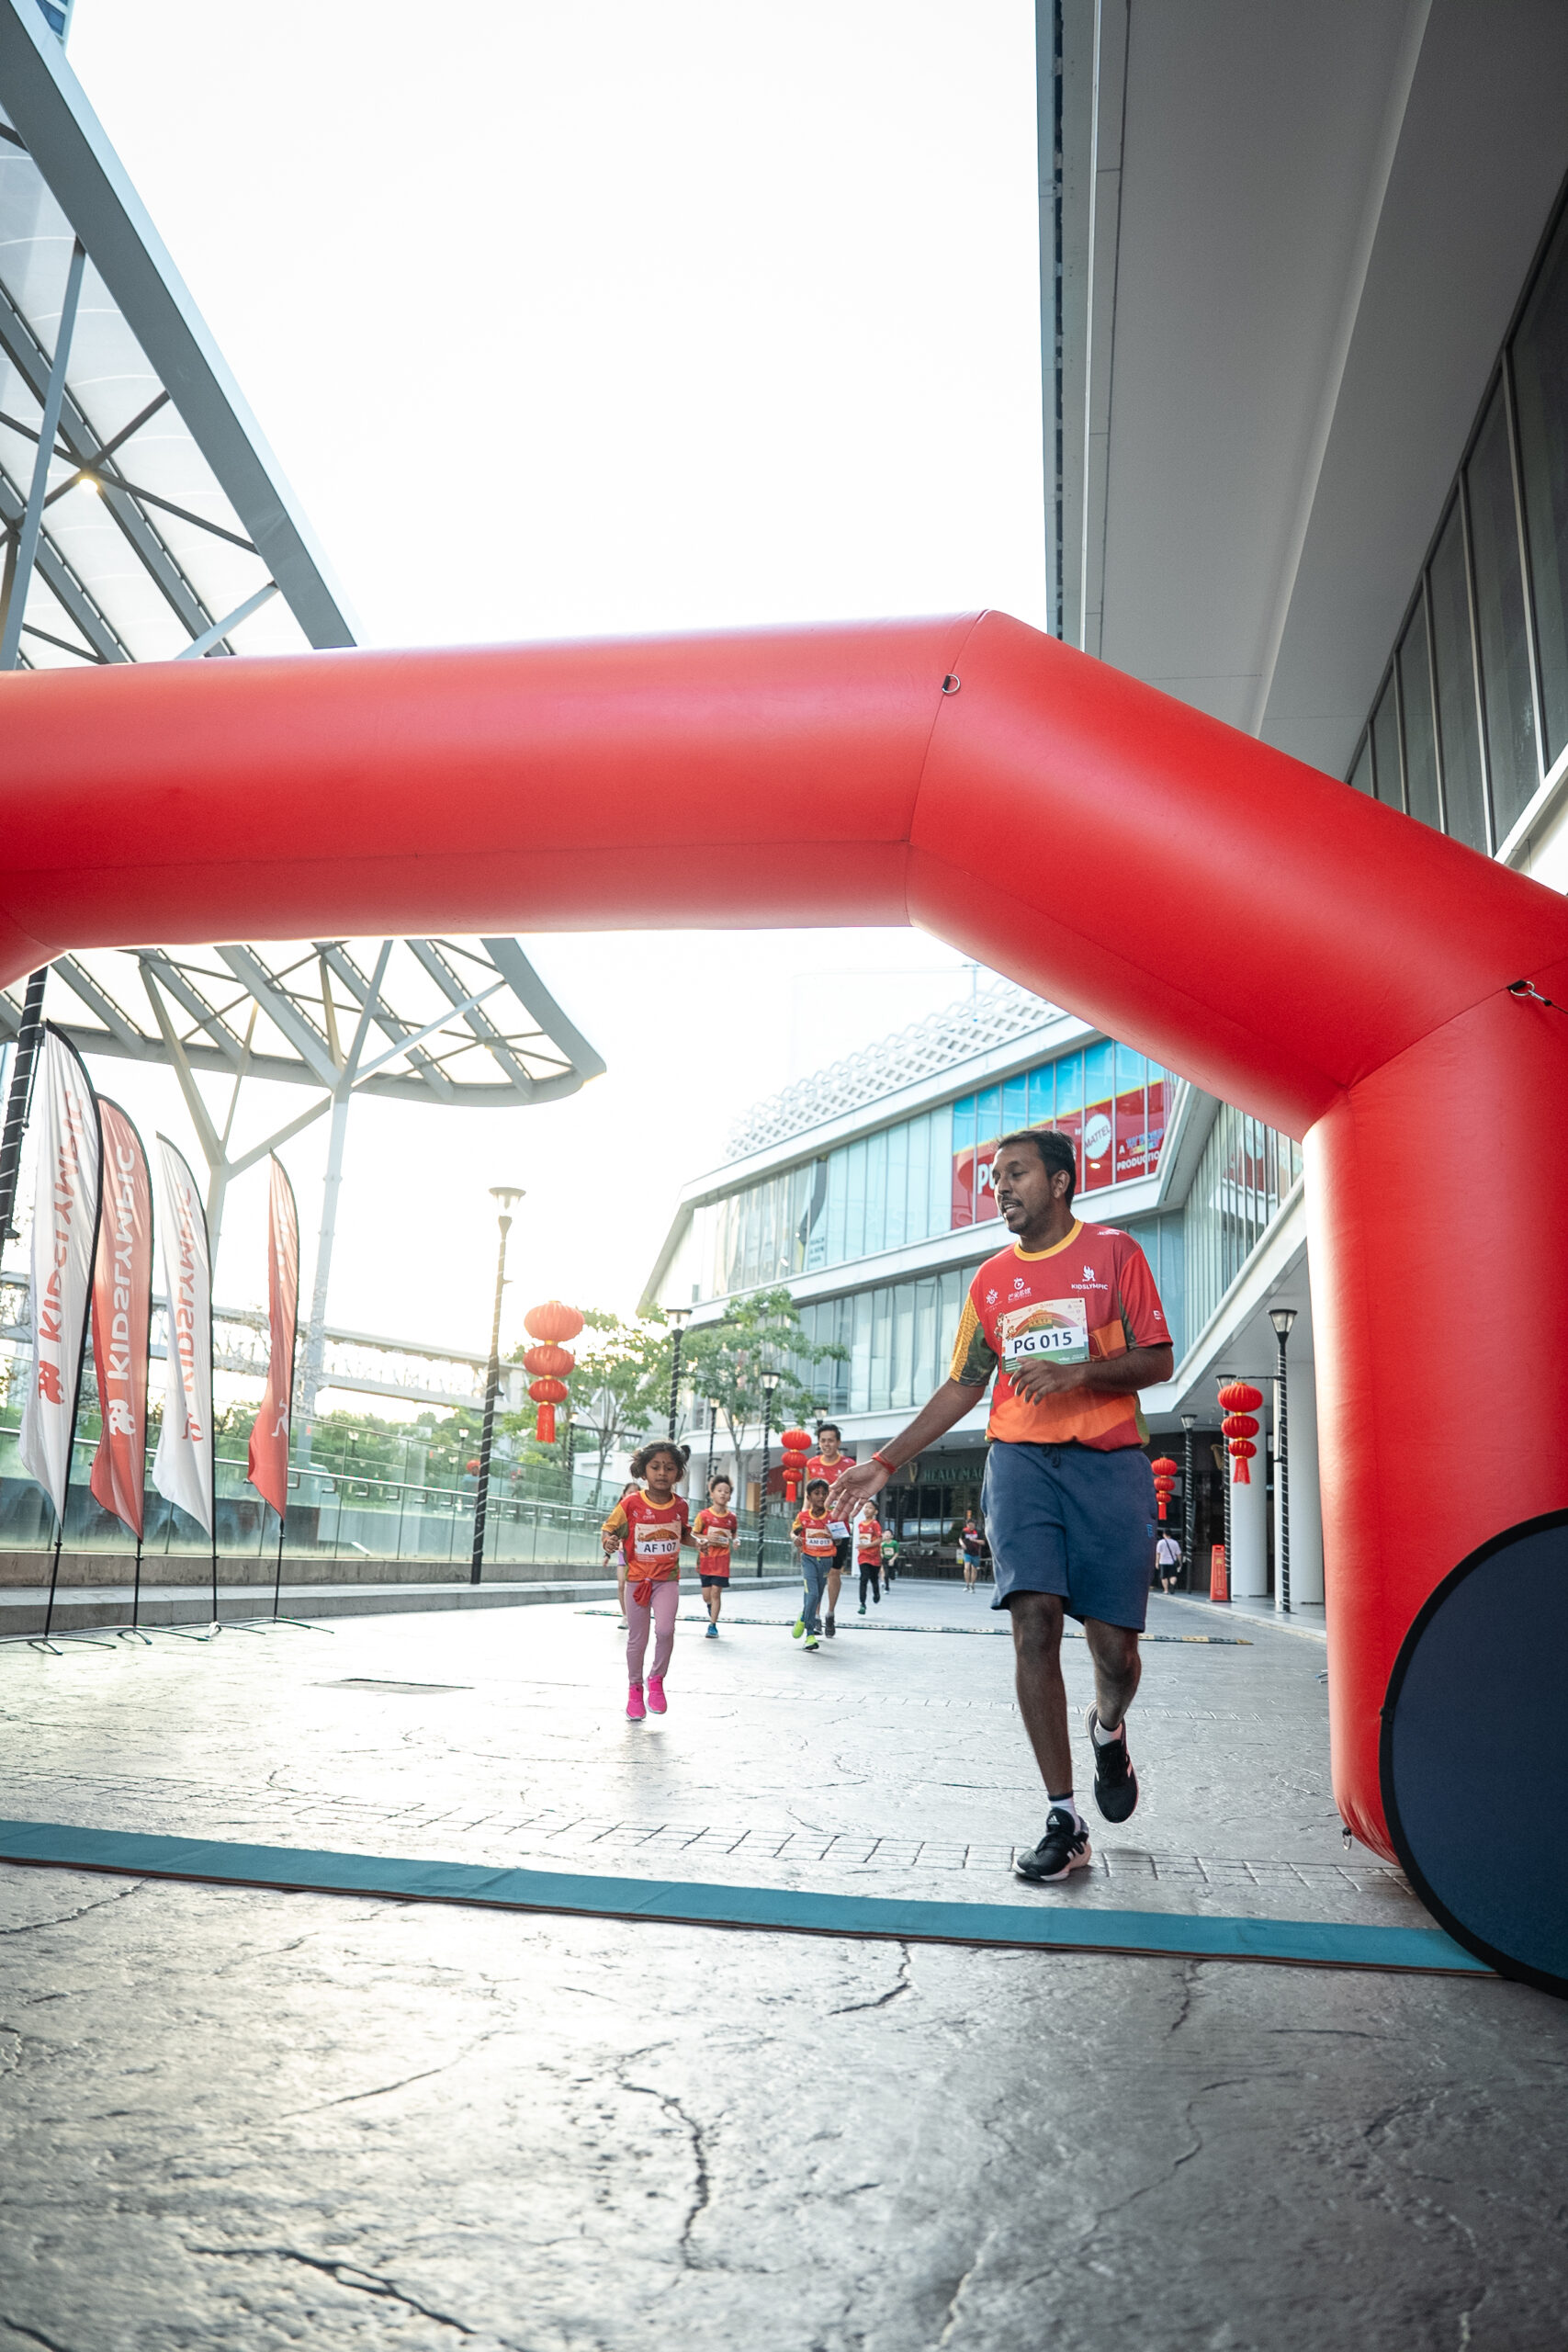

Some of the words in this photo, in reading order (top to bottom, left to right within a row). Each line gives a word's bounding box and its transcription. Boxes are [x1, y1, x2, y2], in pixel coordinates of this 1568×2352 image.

[1117, 1150, 1160, 1171] PRODUCTIO
[1014, 1337, 1035, 1354] PG
[1040, 1331, 1072, 1349] 015
[644, 1544, 658, 1553] AF
[661, 1542, 677, 1553] 107
